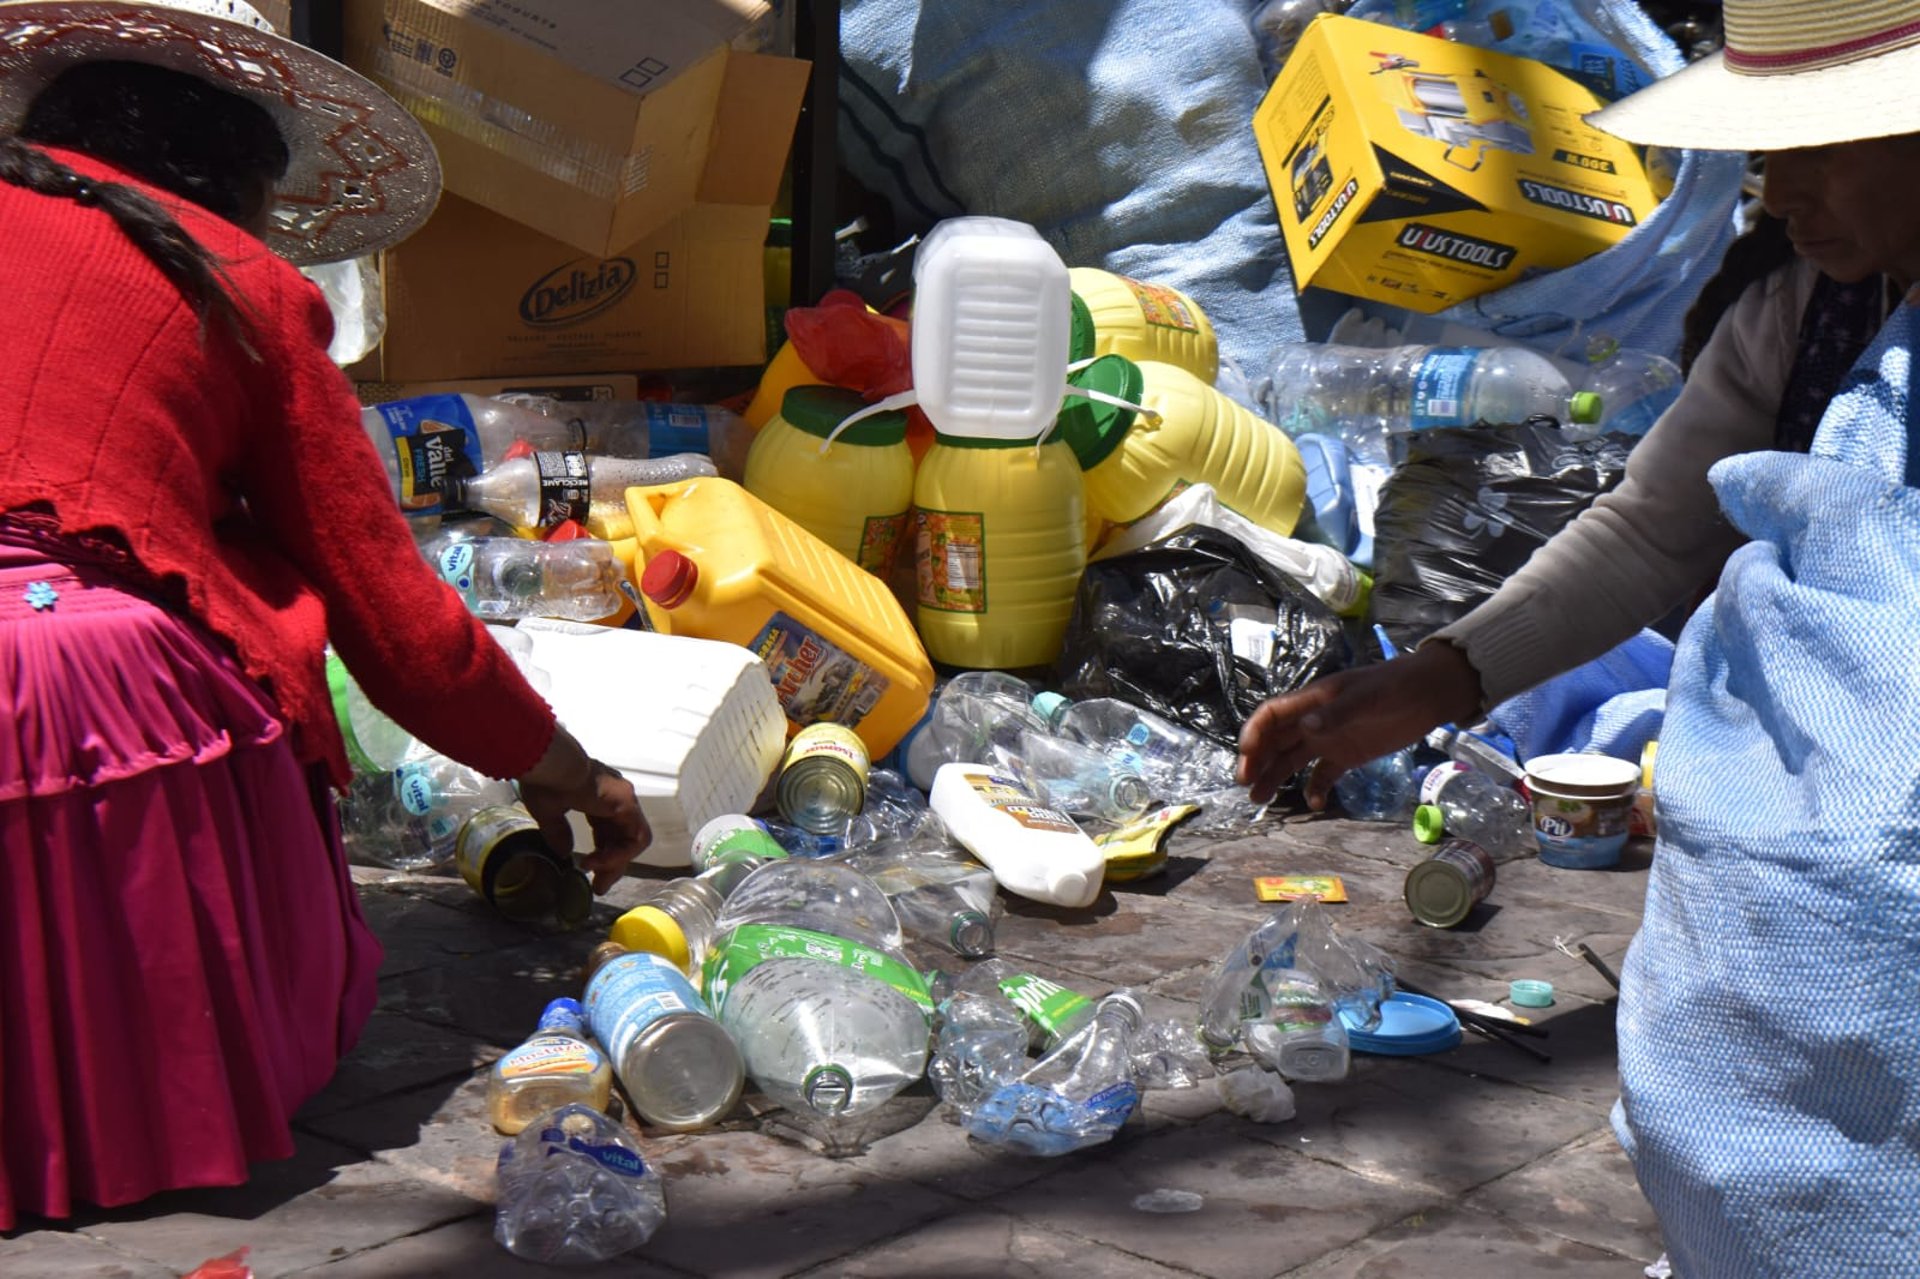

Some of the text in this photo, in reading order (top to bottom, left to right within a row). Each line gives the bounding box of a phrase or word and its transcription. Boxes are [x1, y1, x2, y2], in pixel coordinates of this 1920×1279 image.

[535, 263, 623, 319] Delizia
[448, 545, 463, 572] vital
[410, 779, 429, 813] vital
[602, 1149, 641, 1172] vital
